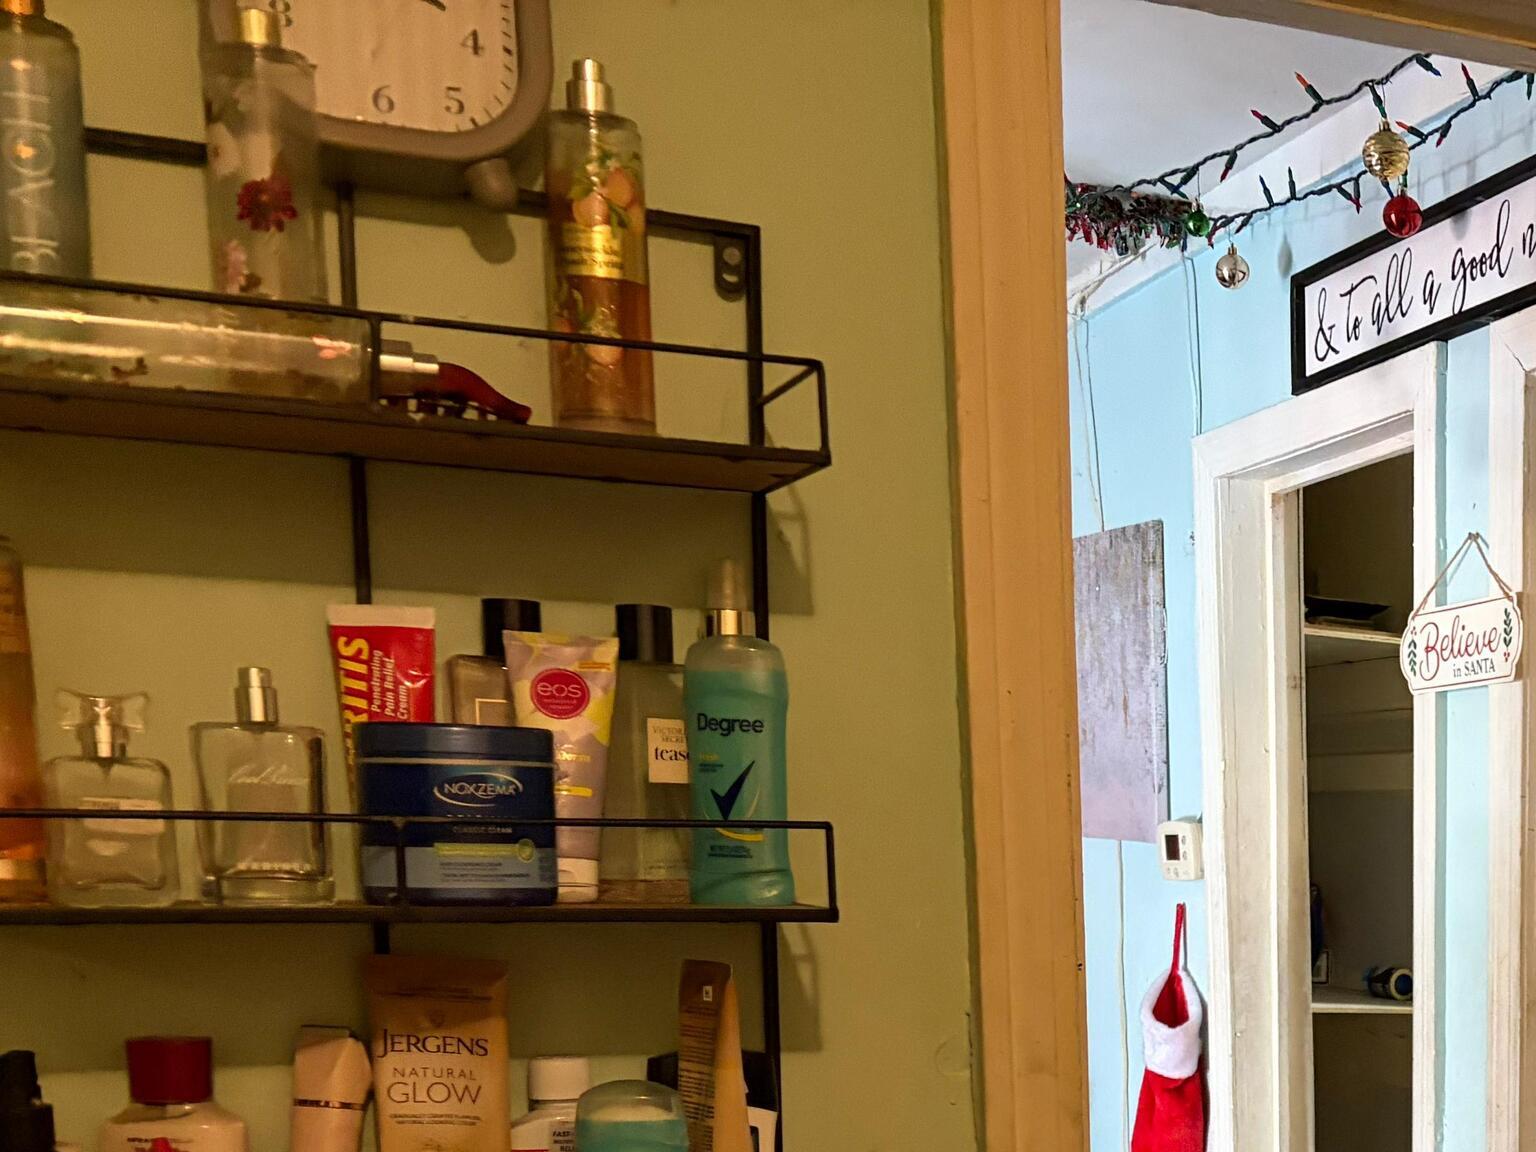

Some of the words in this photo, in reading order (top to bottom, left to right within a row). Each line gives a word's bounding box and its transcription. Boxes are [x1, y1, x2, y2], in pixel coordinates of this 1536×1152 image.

[460, 29, 484, 56] 4
[372, 85, 395, 114] 6
[444, 86, 465, 115] 5
[1314, 288, 1340, 362] &
[1340, 274, 1378, 343] to
[1371, 247, 1414, 336] all
[1423, 270, 1442, 315] a
[1451, 199, 1514, 315] good
[1419, 614, 1502, 681] Believe
[370, 650, 383, 712] Penetrating
[383, 657, 396, 689] Relief
[1452, 663, 1462, 678] in
[1464, 657, 1496, 676] SANTA
[337, 636, 370, 736] RITIS
[537, 682, 582, 698] eos
[384, 690, 396, 716] Pain
[397, 685, 409, 720] Cream
[697, 713, 765, 737] Degree
[444, 782, 516, 799] NOXZEMA
[377, 1028, 489, 1058] JERGENS
[393, 1067, 477, 1081] NATURAL
[387, 1082, 482, 1105] GLOW
